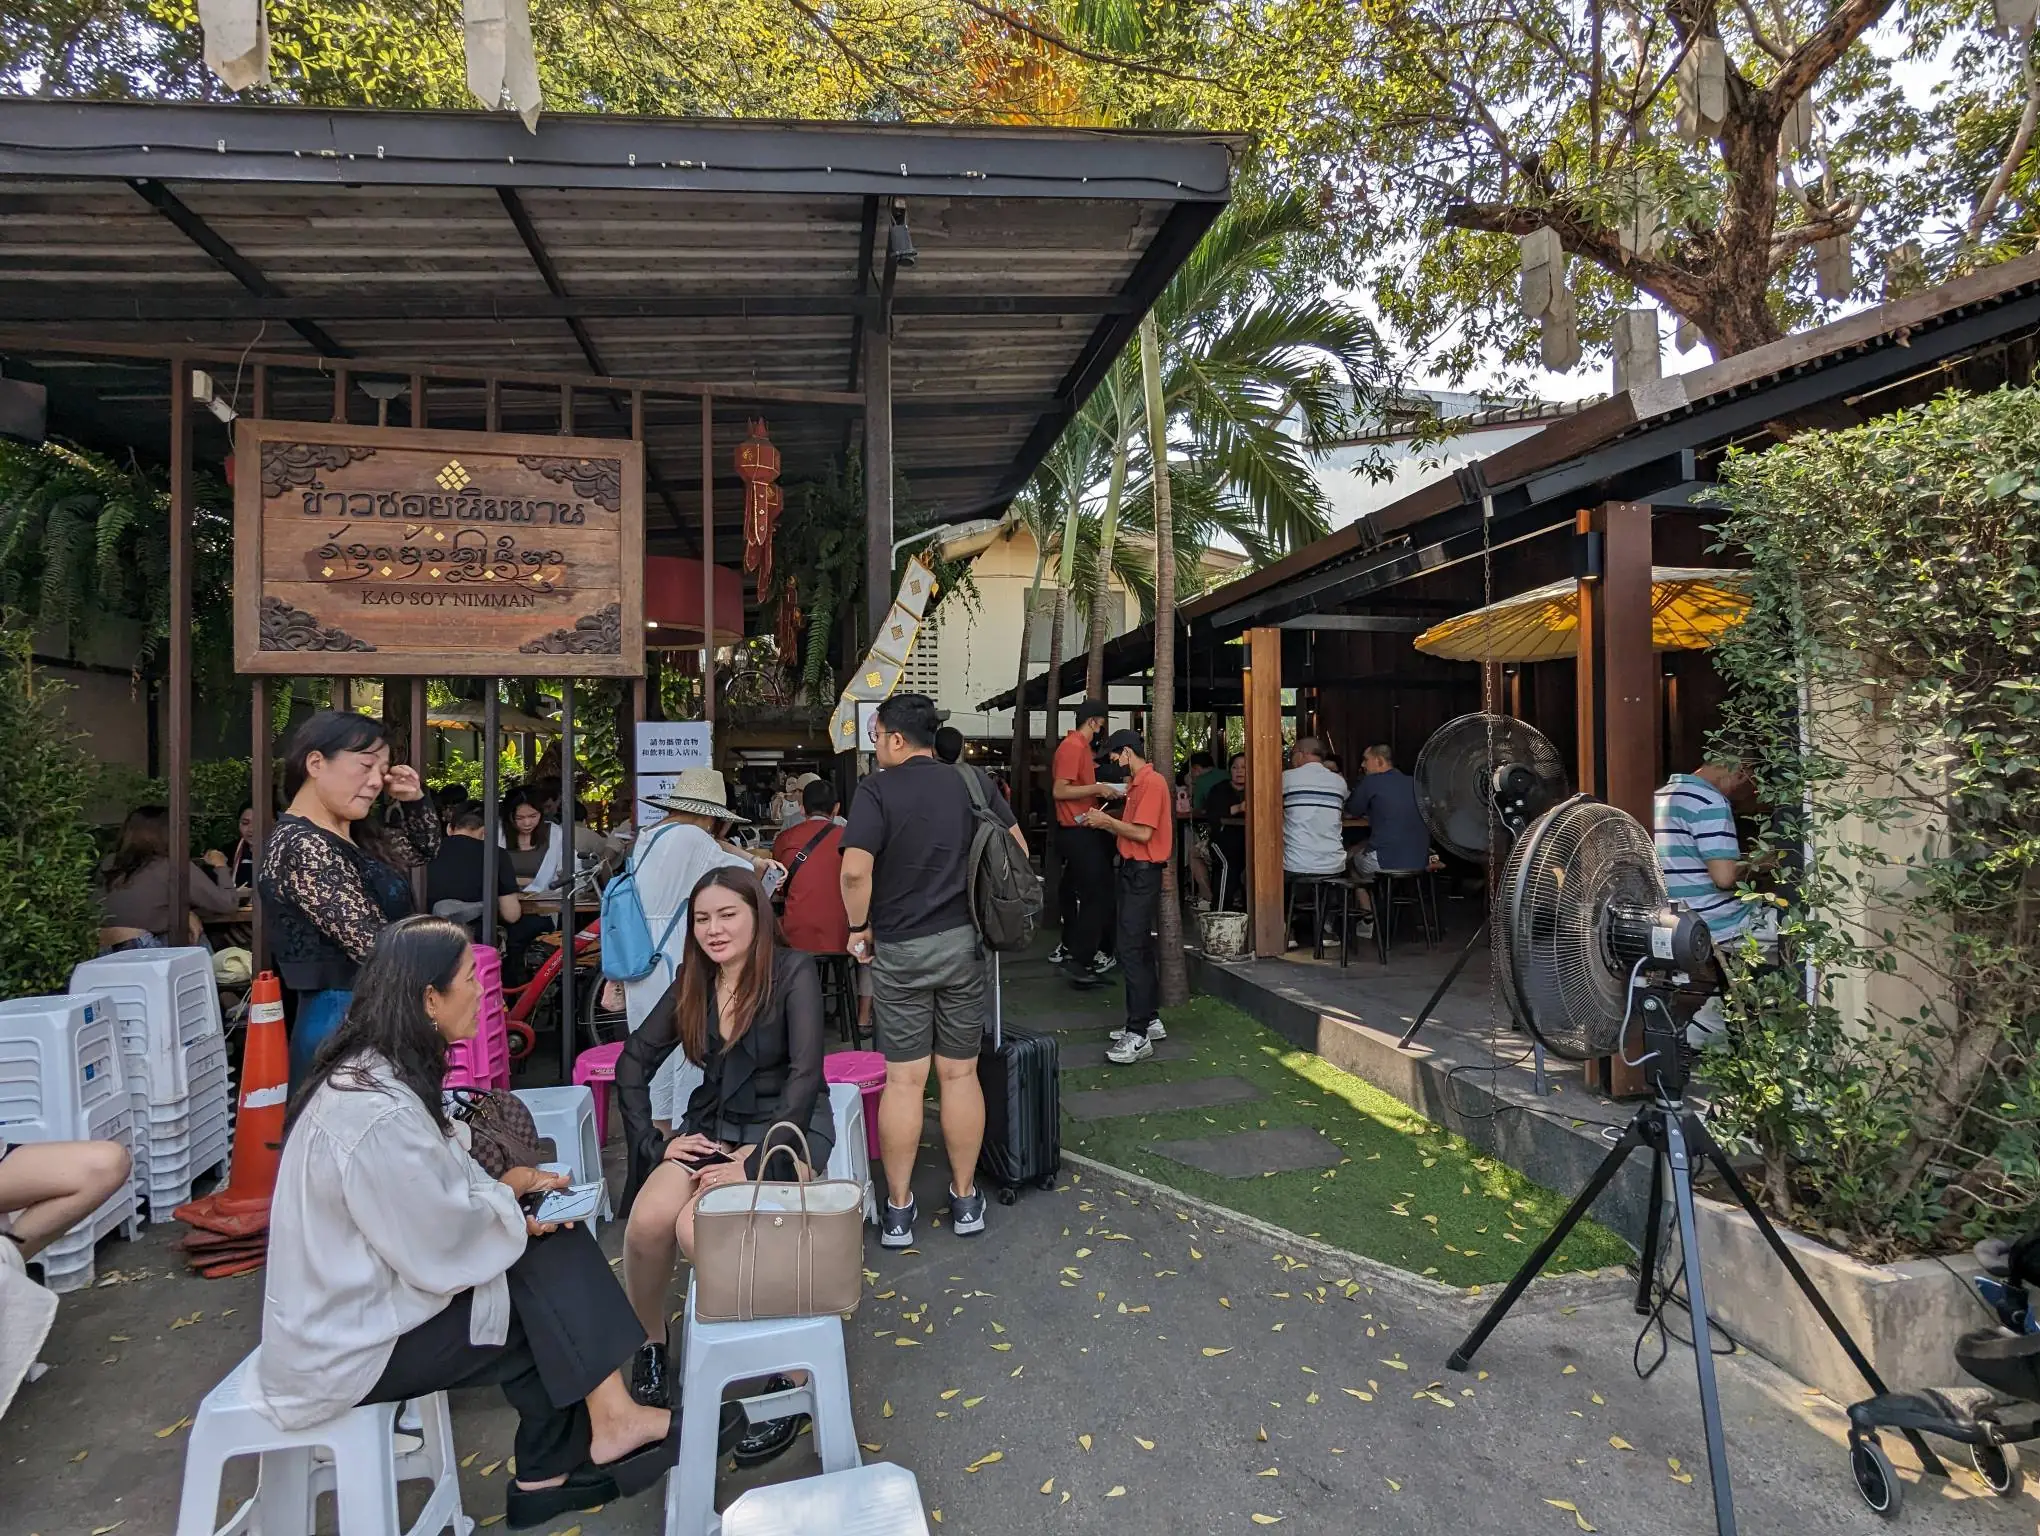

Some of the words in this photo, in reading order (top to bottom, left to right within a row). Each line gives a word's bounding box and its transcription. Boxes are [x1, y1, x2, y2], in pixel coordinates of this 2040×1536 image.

[302, 481, 586, 525] ข้าวซอยนิมมาน
[361, 590, 405, 606] KAO
[410, 591, 446, 607] SOY
[453, 592, 536, 608] NIMMAN
